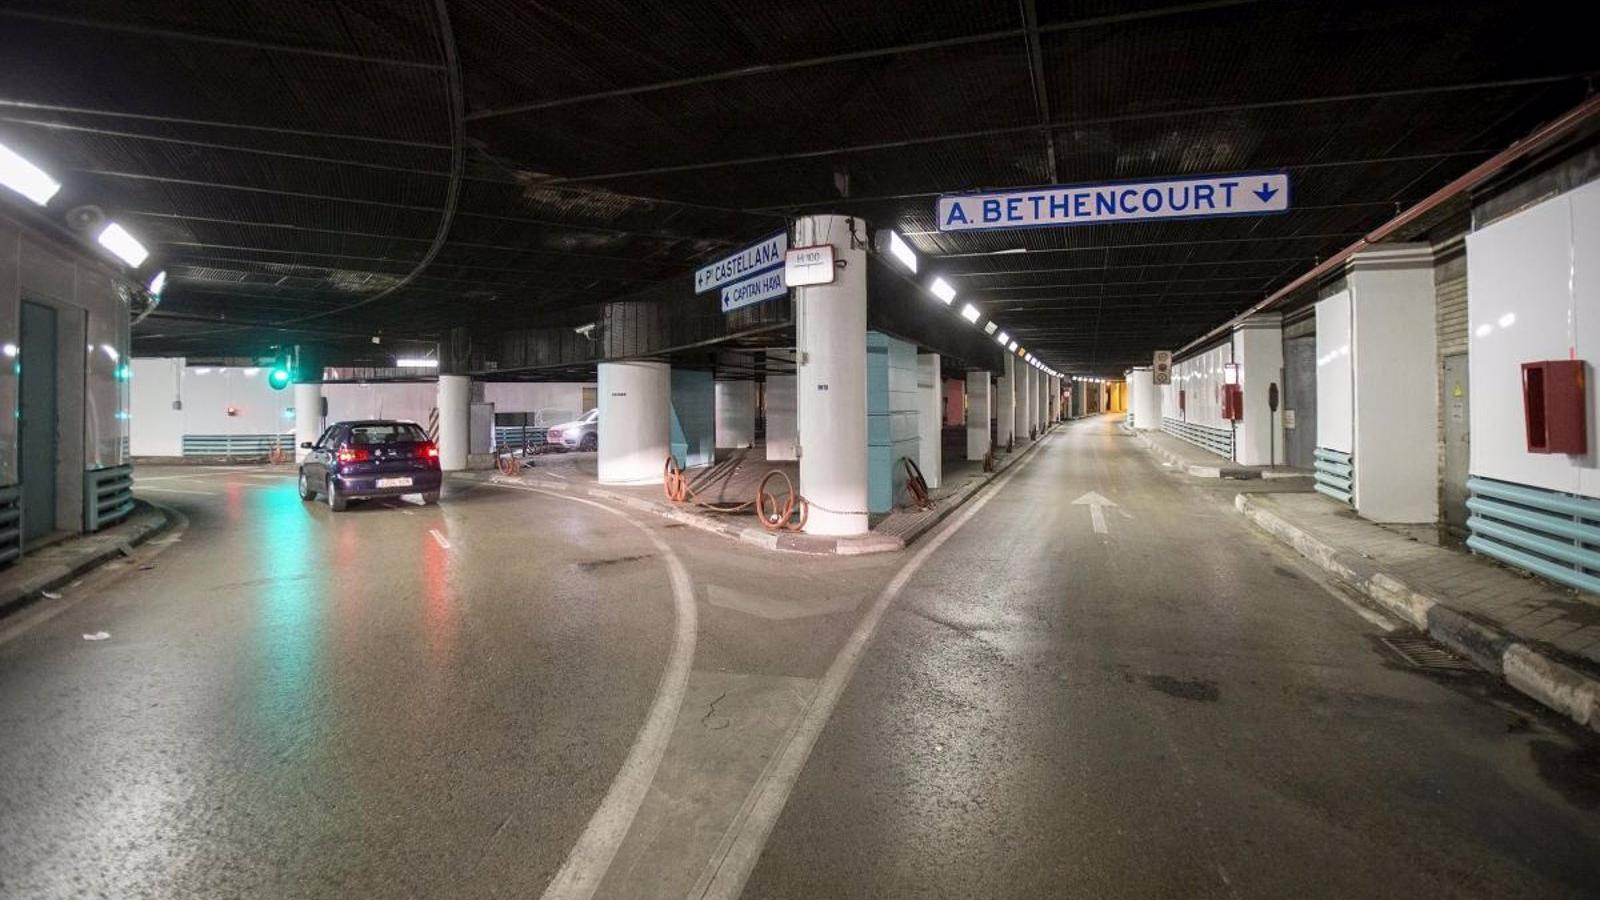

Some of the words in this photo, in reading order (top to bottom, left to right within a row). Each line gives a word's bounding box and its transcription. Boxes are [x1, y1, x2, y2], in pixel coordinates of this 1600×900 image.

[946, 202, 974, 225] A.
[983, 182, 1239, 223] BETHENCOURT
[715, 241, 779, 282] CASTELLANA
